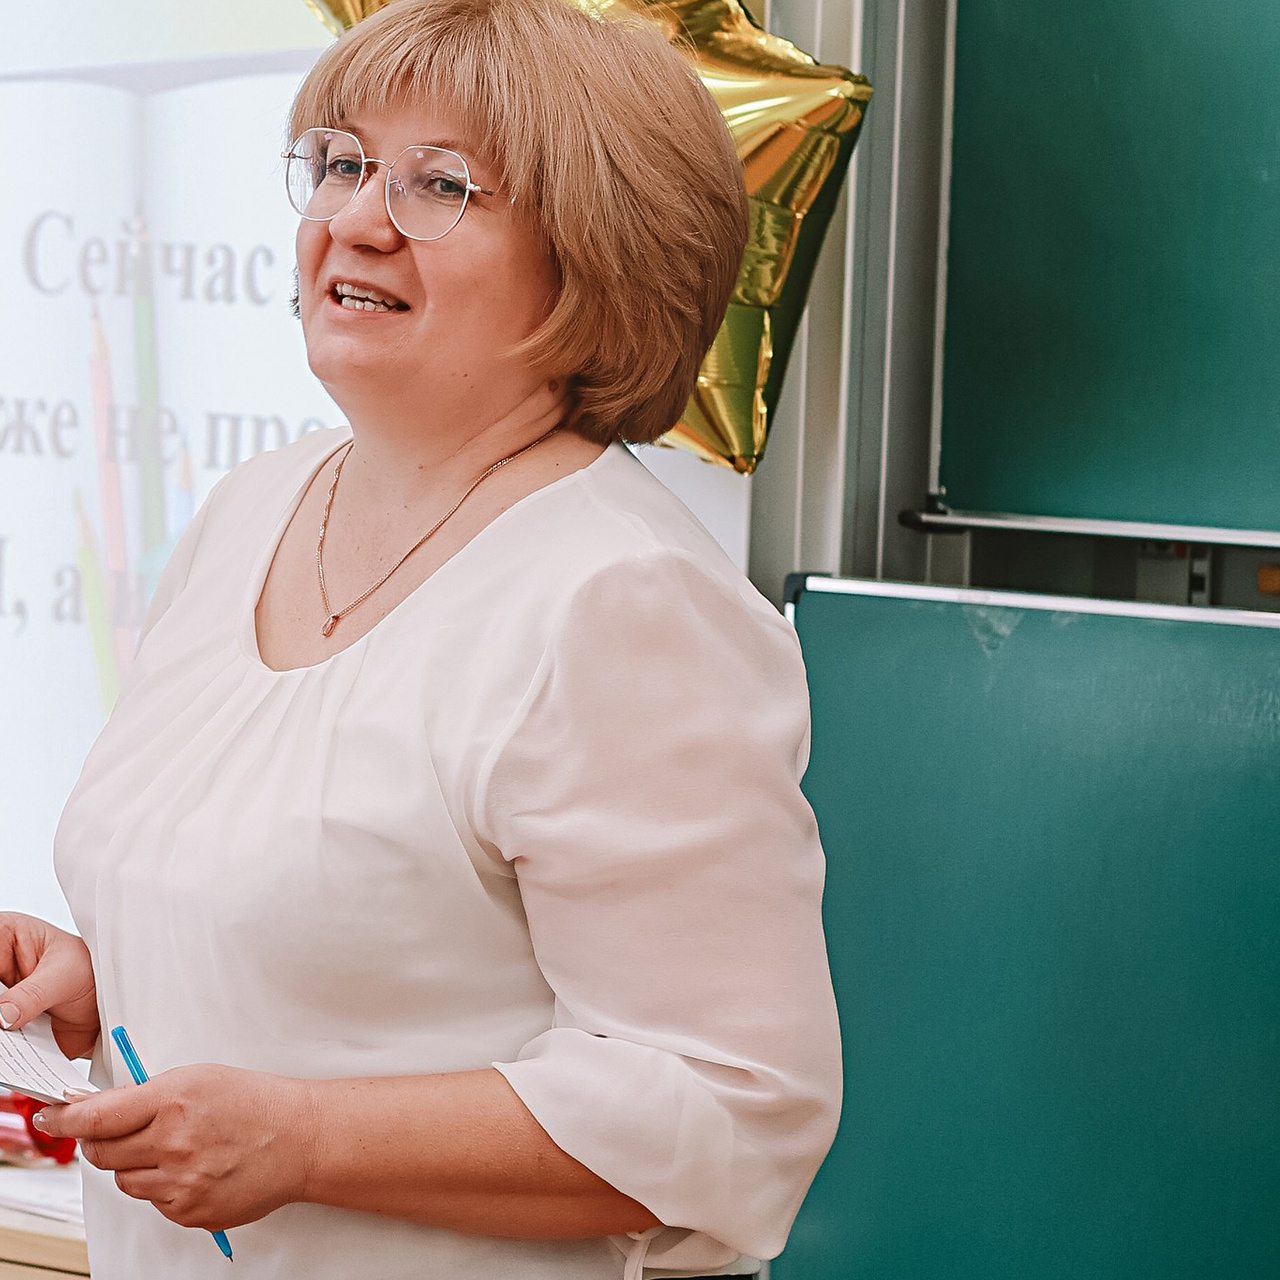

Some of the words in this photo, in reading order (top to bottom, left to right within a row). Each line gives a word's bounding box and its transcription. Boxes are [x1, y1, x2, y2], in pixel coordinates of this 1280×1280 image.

[21, 208, 275, 307] Сейчас
[106, 402, 179, 466] не
[51, 563, 85, 626] а
